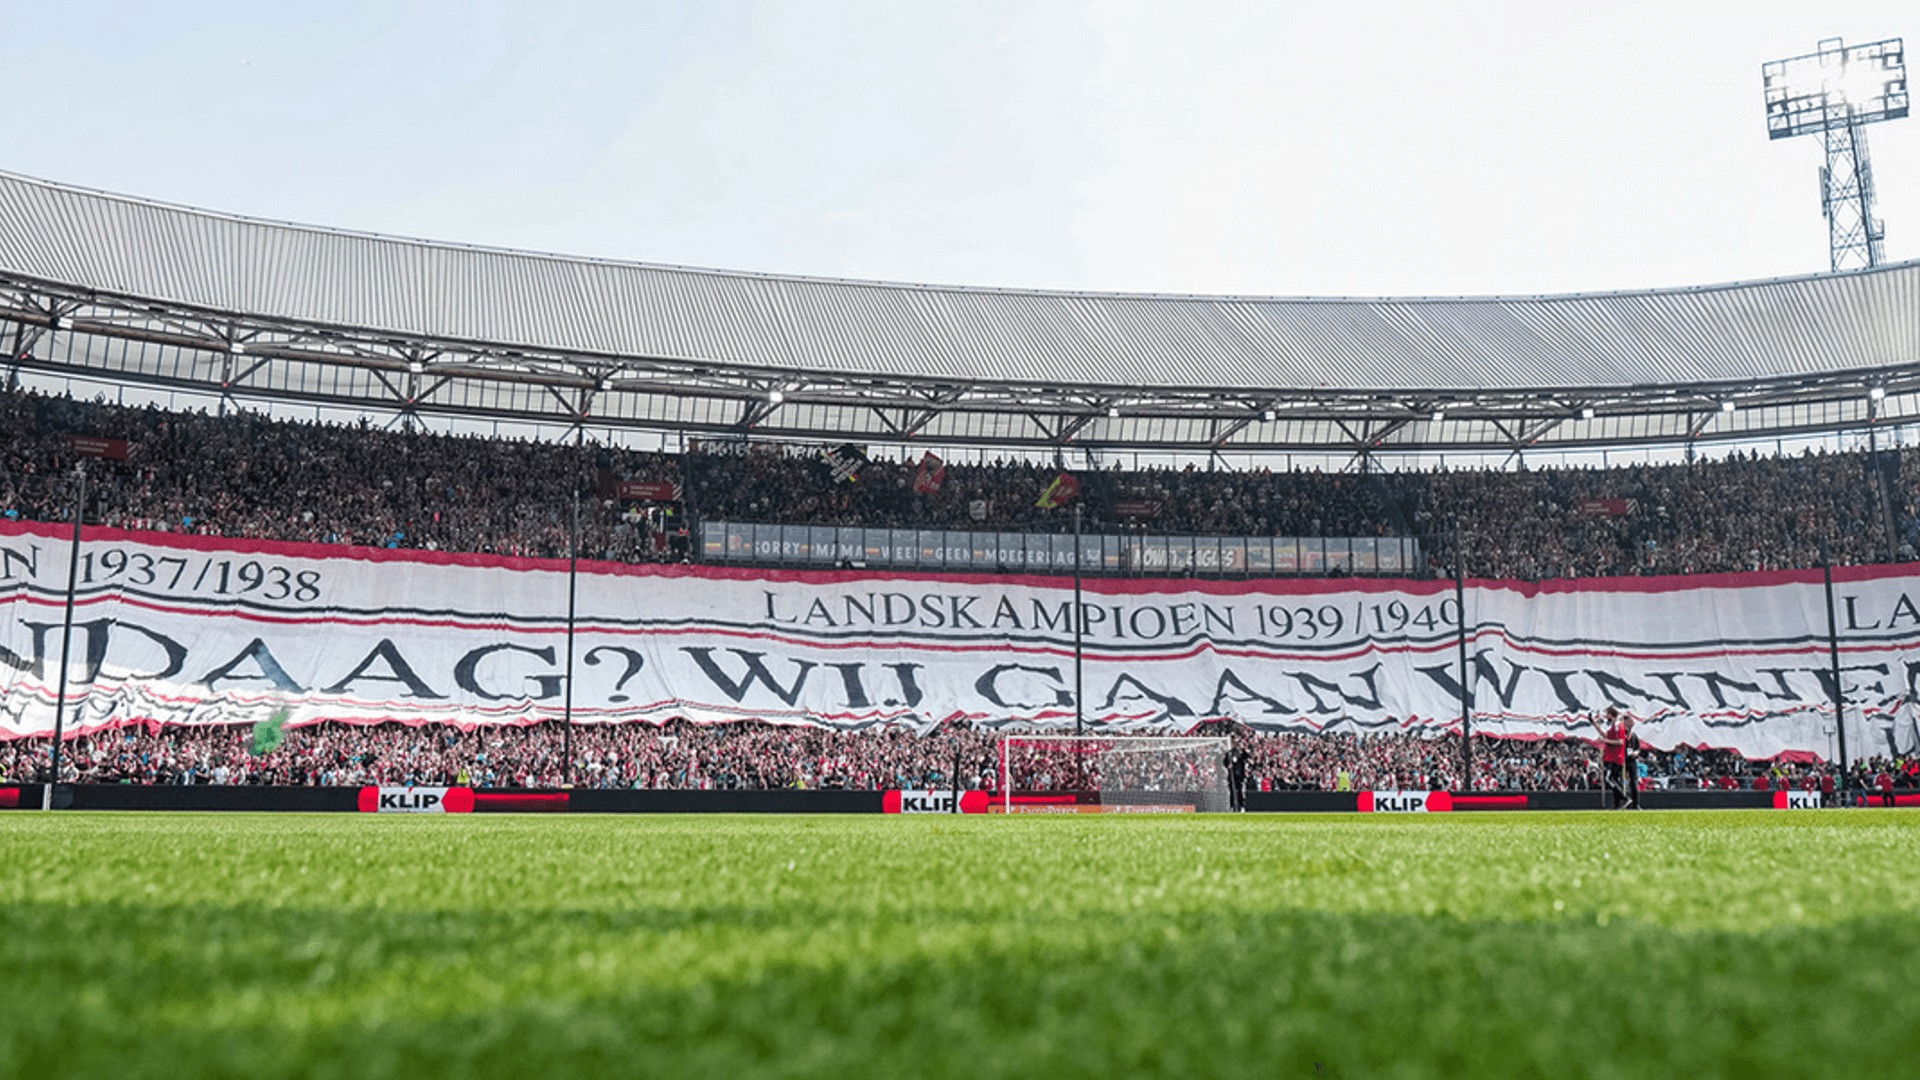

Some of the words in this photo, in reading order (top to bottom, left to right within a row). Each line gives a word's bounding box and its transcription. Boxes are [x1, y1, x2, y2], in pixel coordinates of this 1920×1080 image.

[79, 549, 321, 602] 1937/1938
[763, 590, 1236, 641] LANDSKAMPIOEN
[1256, 598, 1464, 640] 1939/1940
[679, 646, 925, 708] WIJ
[975, 662, 1384, 716] GAAN
[380, 794, 440, 809] KLIP
[1375, 798, 1423, 811] KLIP
